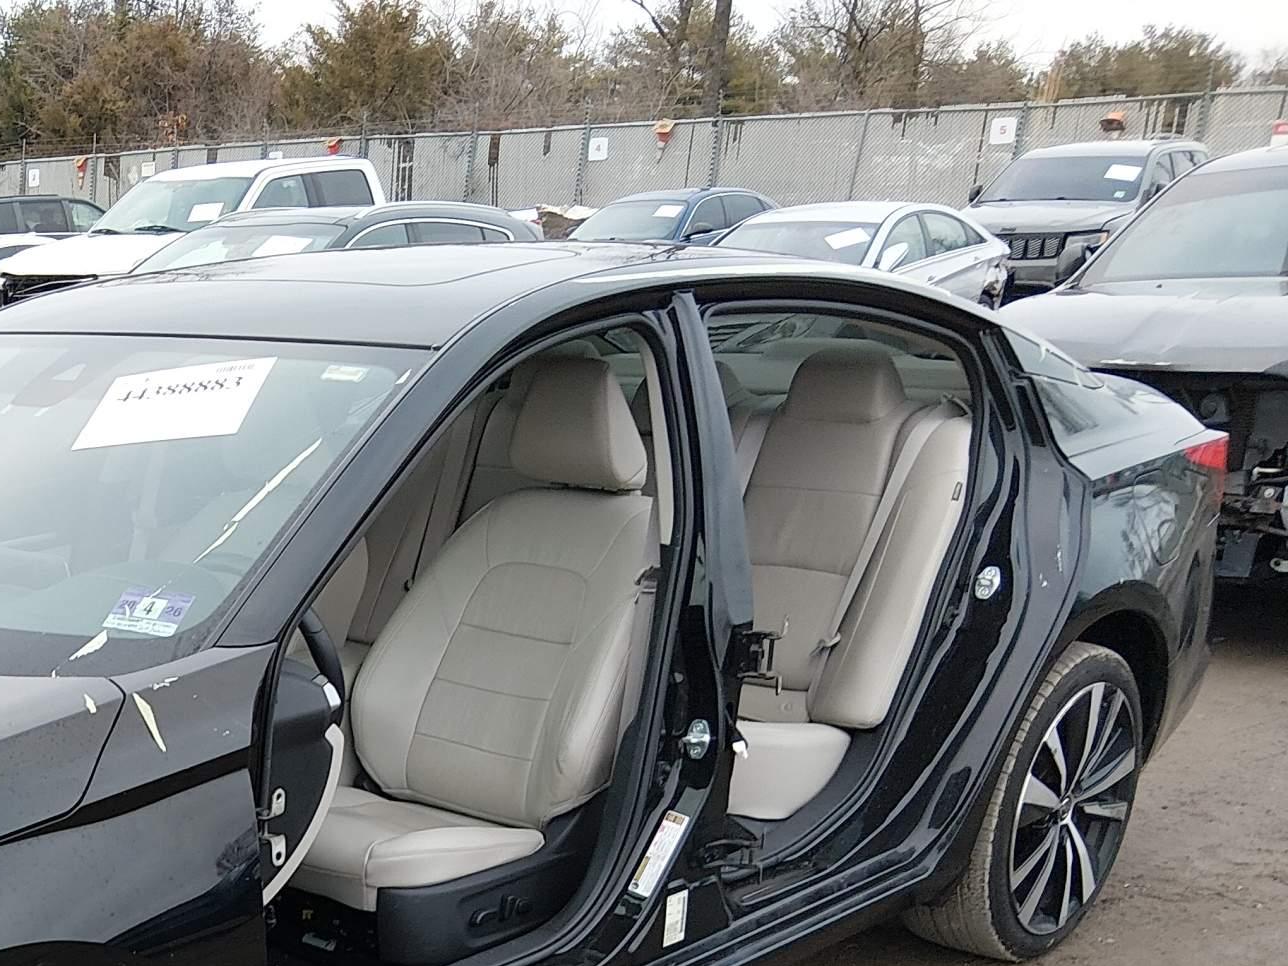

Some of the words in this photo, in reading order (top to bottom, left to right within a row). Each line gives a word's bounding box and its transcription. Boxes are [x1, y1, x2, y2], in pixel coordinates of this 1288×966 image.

[116, 376, 244, 402] 44388883
[143, 600, 156, 616] 4
[165, 606, 183, 617] 26
